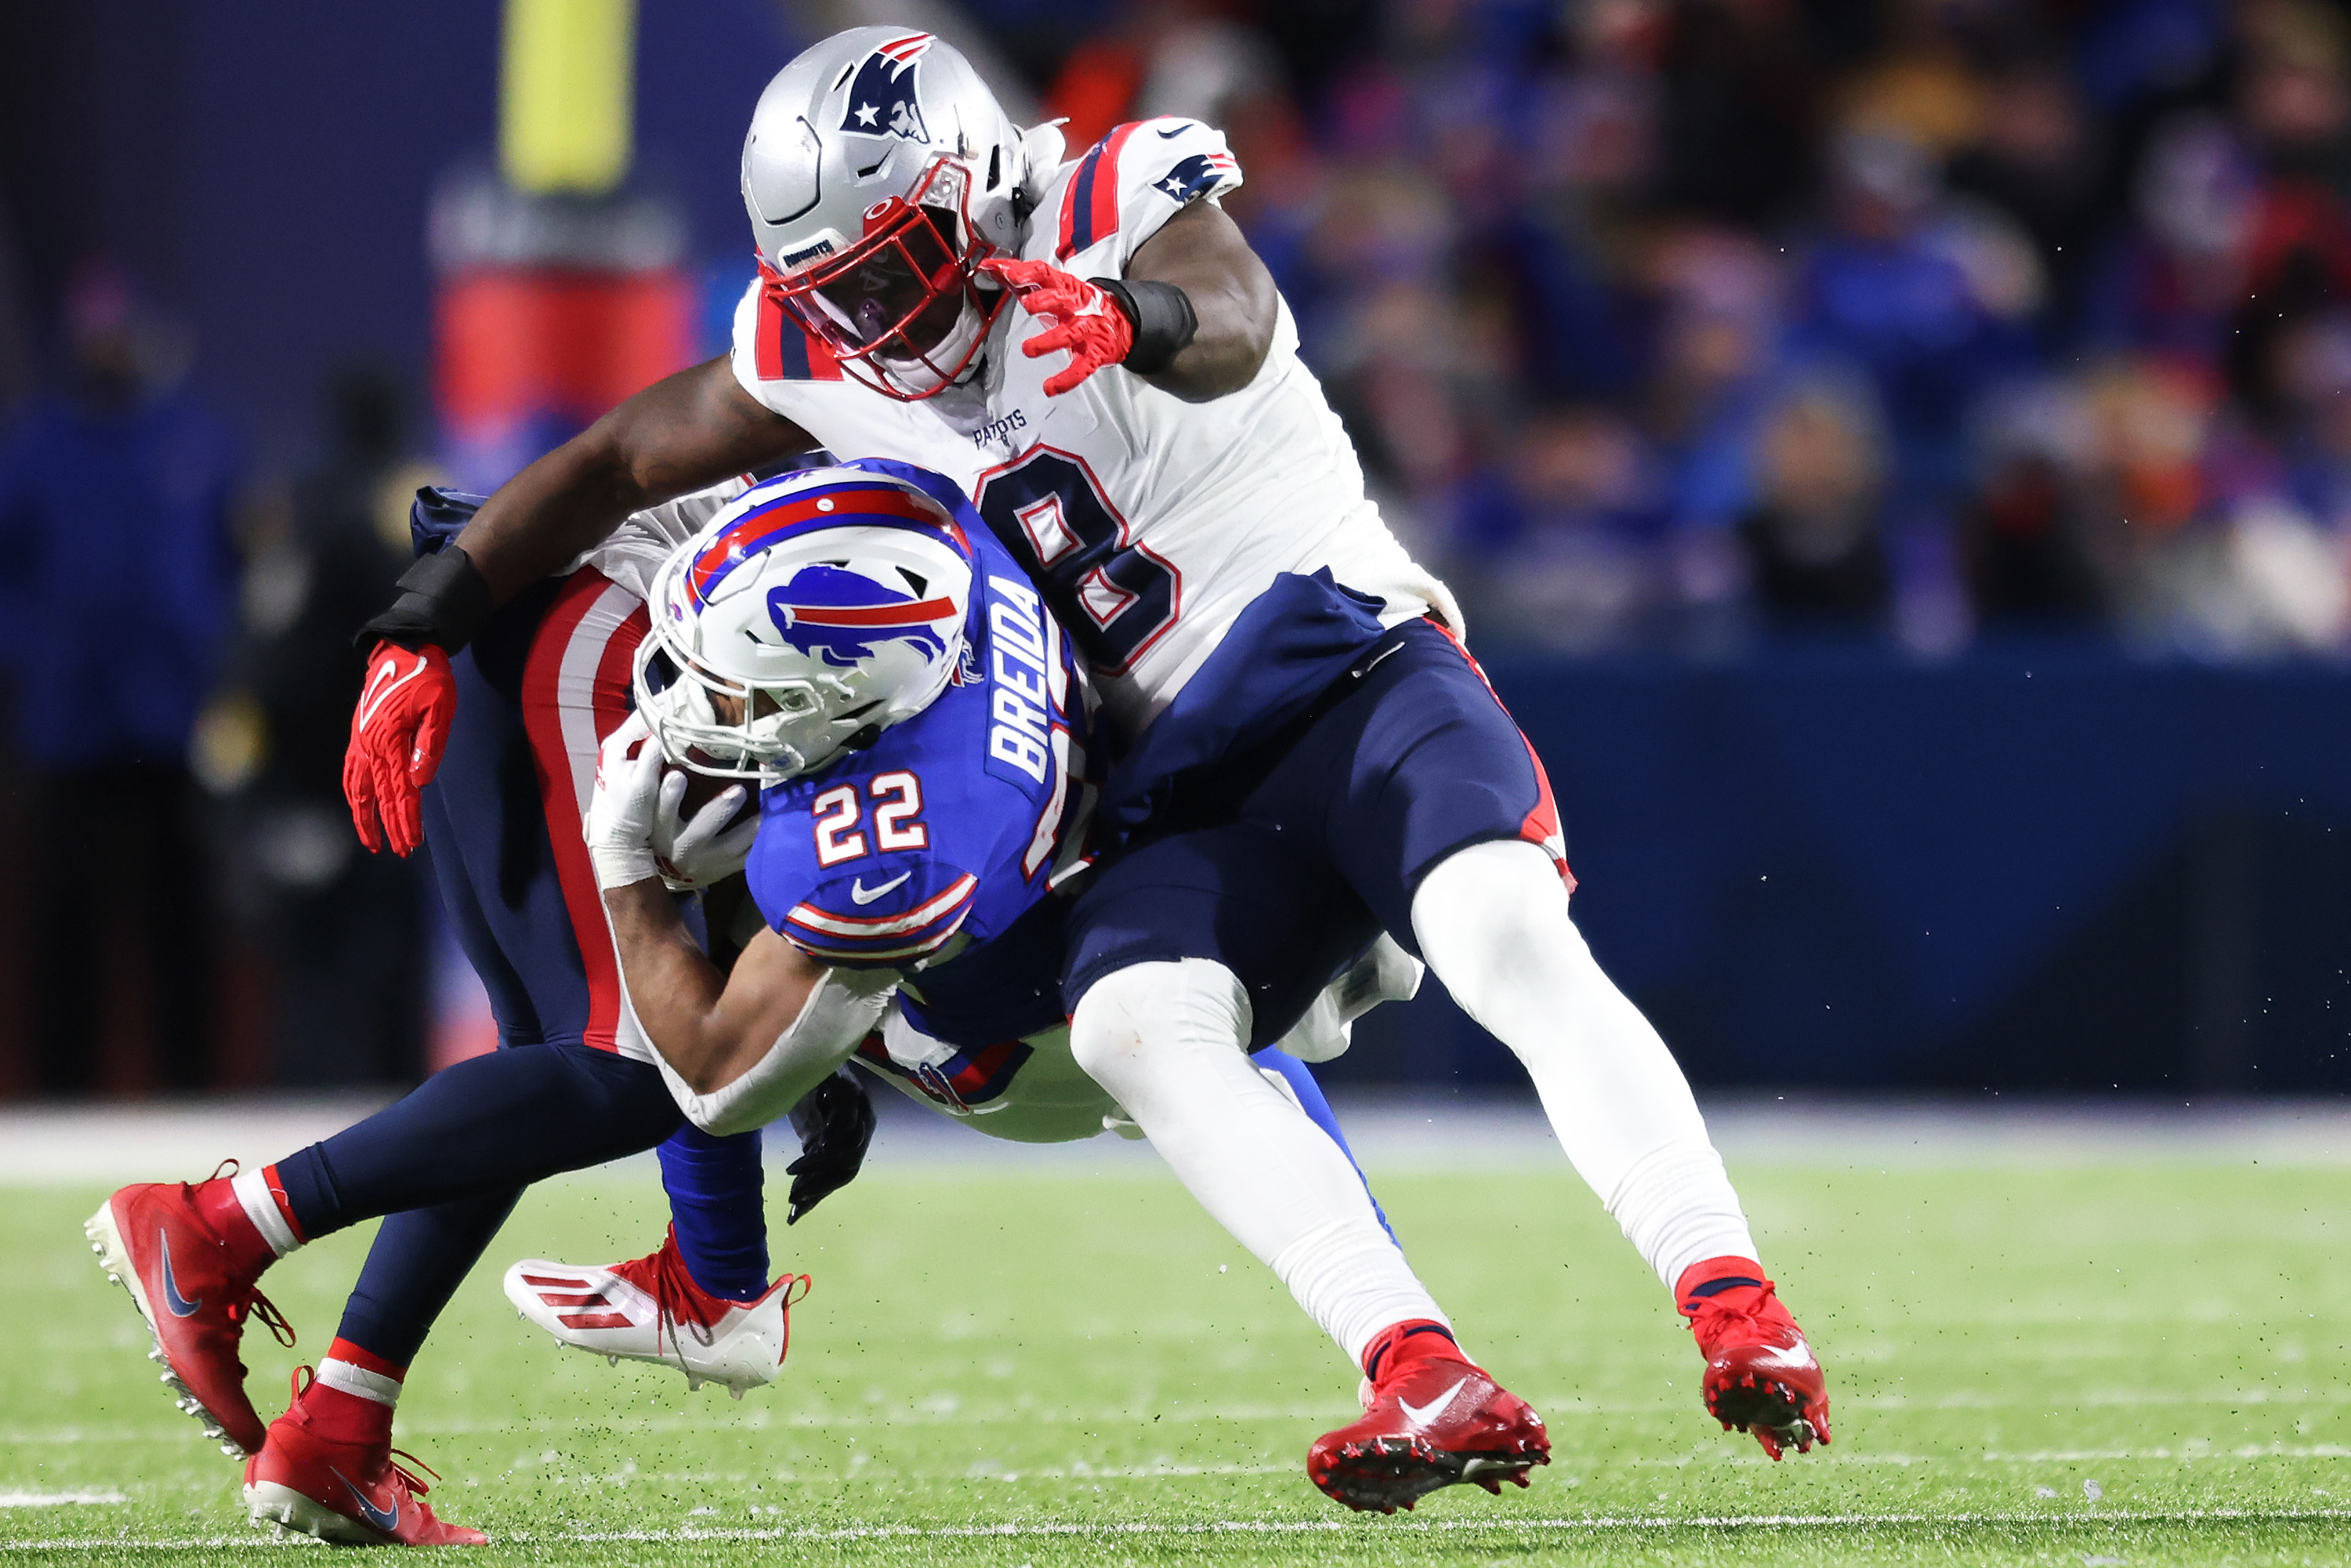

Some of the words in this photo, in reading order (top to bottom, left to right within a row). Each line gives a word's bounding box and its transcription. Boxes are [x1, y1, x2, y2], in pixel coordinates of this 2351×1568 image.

[973, 408, 1027, 451] PATOTS
[973, 443, 1182, 677] 8
[989, 574, 1049, 784] BREIDA
[812, 769, 930, 868] 22
